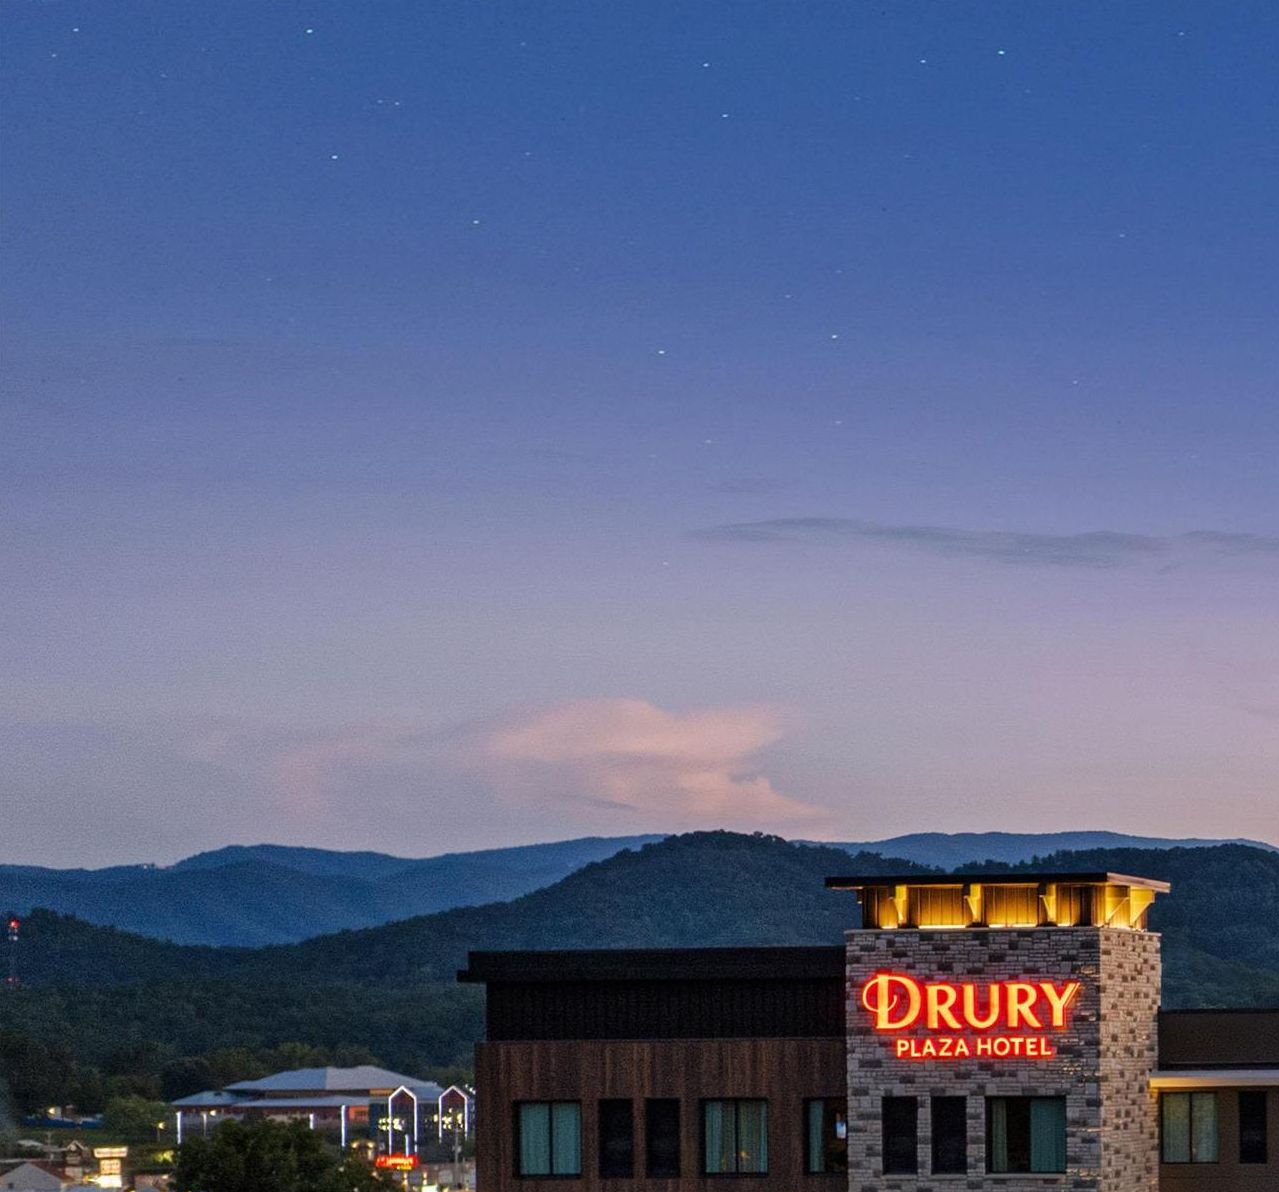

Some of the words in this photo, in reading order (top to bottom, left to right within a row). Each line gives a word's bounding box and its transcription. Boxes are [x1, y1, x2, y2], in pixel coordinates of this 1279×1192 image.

[862, 974, 1080, 1029] DRURY
[897, 1039, 969, 1057] PLAZA
[977, 1037, 1051, 1056] HOTEL
